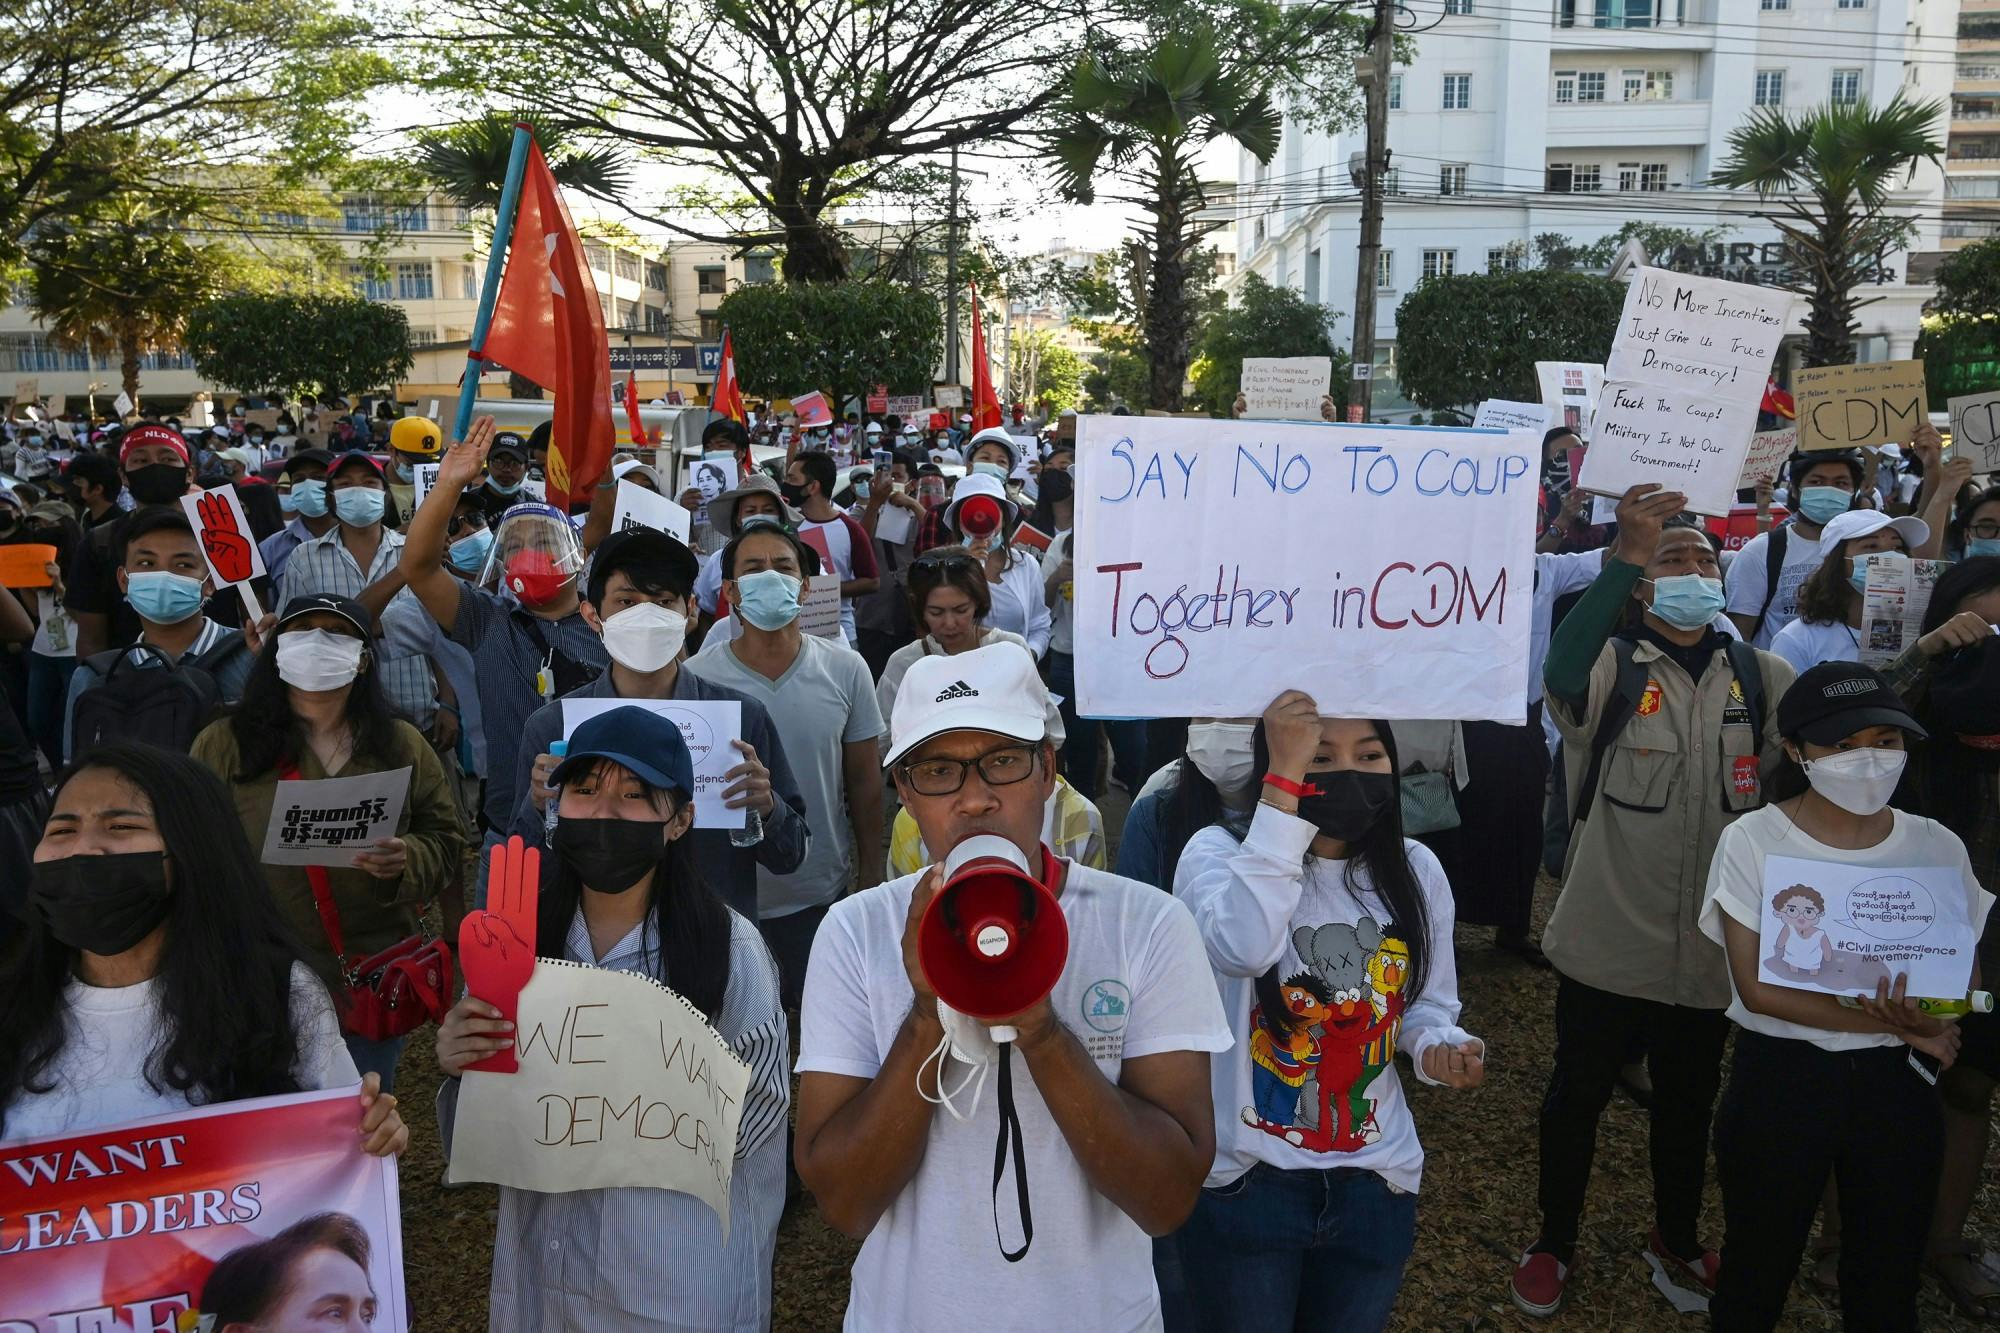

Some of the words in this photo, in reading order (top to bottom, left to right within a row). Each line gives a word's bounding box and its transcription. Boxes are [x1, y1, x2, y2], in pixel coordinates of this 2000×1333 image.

[1638, 277, 1663, 310] No
[1673, 287, 1709, 314] More
[1714, 299, 1780, 326] Incentives
[1628, 317, 1659, 340] Just
[1664, 329, 1690, 345] Give
[1700, 335, 1713, 347] Us
[1731, 338, 1766, 358] True
[1641, 348, 1738, 385] Democracy!
[1613, 389, 1645, 409] Fuck
[1656, 398, 1672, 413] The
[1686, 404, 1722, 423] Coup!
[144, 431, 169, 439] NLD
[1604, 422, 1651, 446] Military
[1657, 431, 1671, 445] Is
[1679, 435, 1696, 449] Not
[1701, 438, 1724, 454] Our
[1100, 437, 1198, 502] SAY
[1630, 449, 1701, 474] Government!
[1097, 561, 1300, 680] Together
[935, 690, 979, 703] adidas
[1825, 680, 1878, 697] GIORDANO
[980, 936, 1006, 945] MEGAPHONE
[1837, 941, 1871, 953] #Civil
[1873, 943, 1957, 956] Disobedience
[1861, 952, 1924, 963] Movement
[516, 1003, 608, 1064] WE
[660, 1019, 736, 1126] WANT
[5, 1135, 186, 1187] WANT
[534, 1094, 731, 1204] DEMOCRACY
